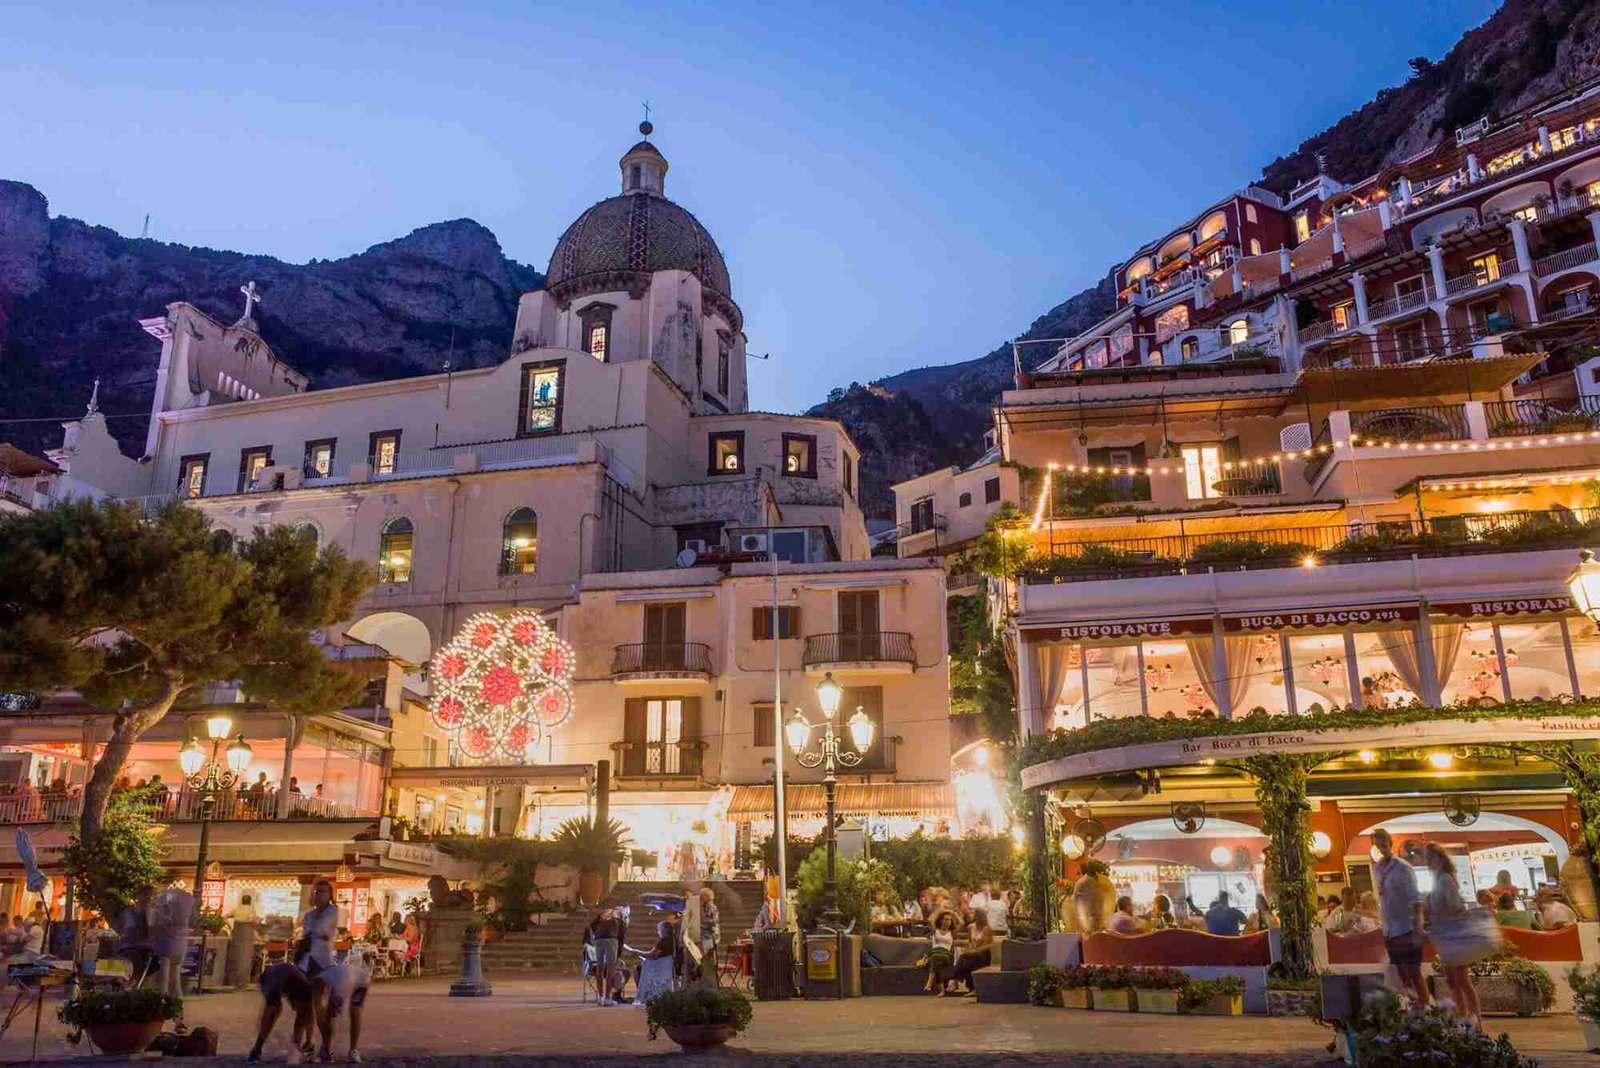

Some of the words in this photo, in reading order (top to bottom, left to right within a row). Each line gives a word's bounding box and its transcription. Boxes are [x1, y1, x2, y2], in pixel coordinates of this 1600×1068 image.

[1471, 597, 1574, 614] RISTORAN
[1240, 614, 1285, 628] BUCA
[1290, 614, 1309, 625] DI
[1315, 610, 1371, 624] BACCO
[1375, 610, 1401, 621] 1916
[1060, 622, 1171, 638] RISTORANTE
[1182, 742, 1201, 753] Bar
[1212, 740, 1241, 750] Buca
[1248, 736, 1261, 747] di
[1267, 735, 1305, 746] Bacco
